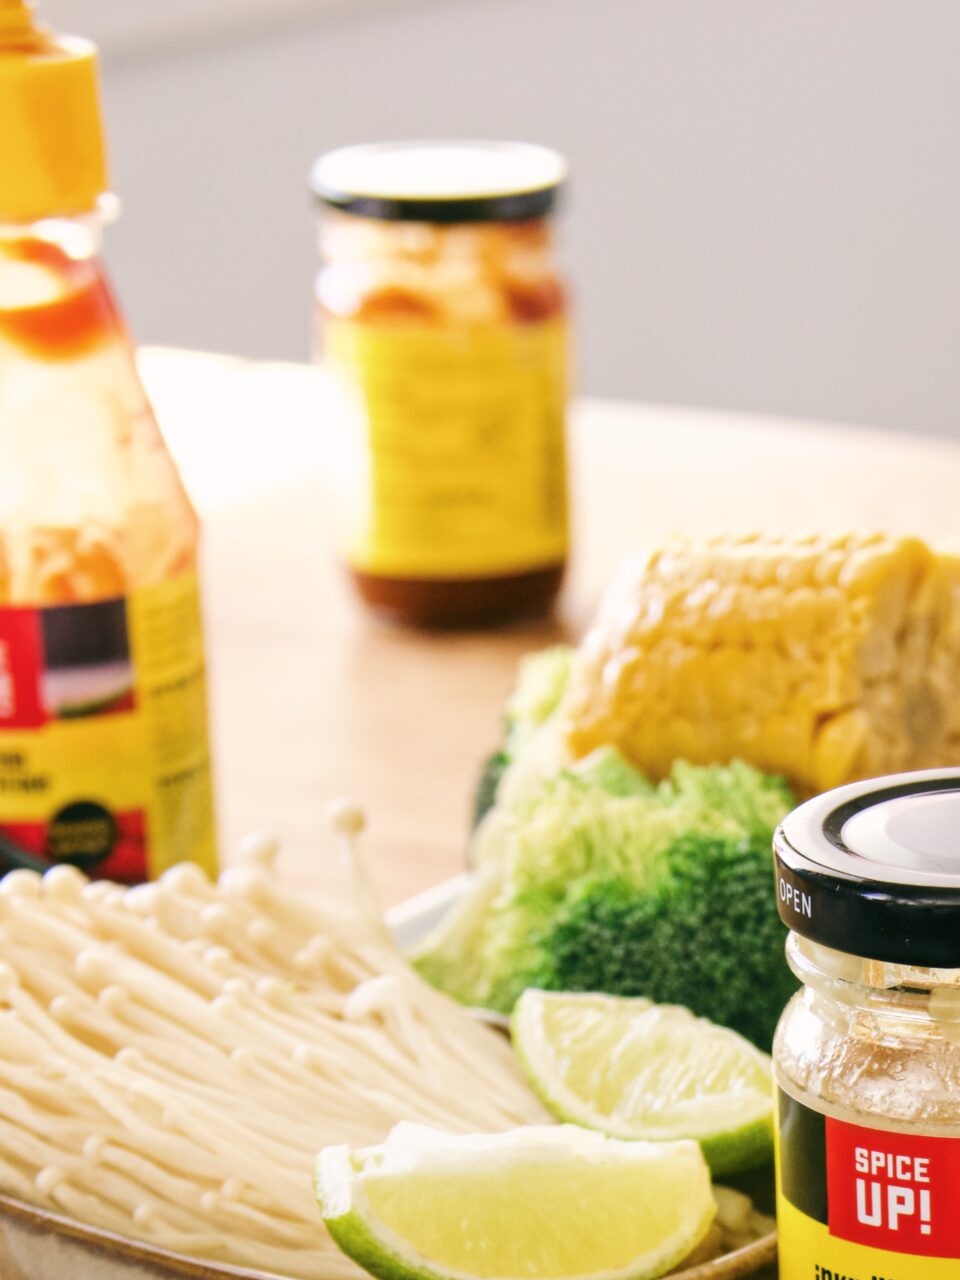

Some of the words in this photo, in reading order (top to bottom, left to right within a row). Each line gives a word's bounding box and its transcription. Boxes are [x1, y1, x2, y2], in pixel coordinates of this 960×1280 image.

[779, 877, 812, 918] OPEN
[854, 1147, 930, 1183] SPICE
[856, 1185, 932, 1236] UP!
